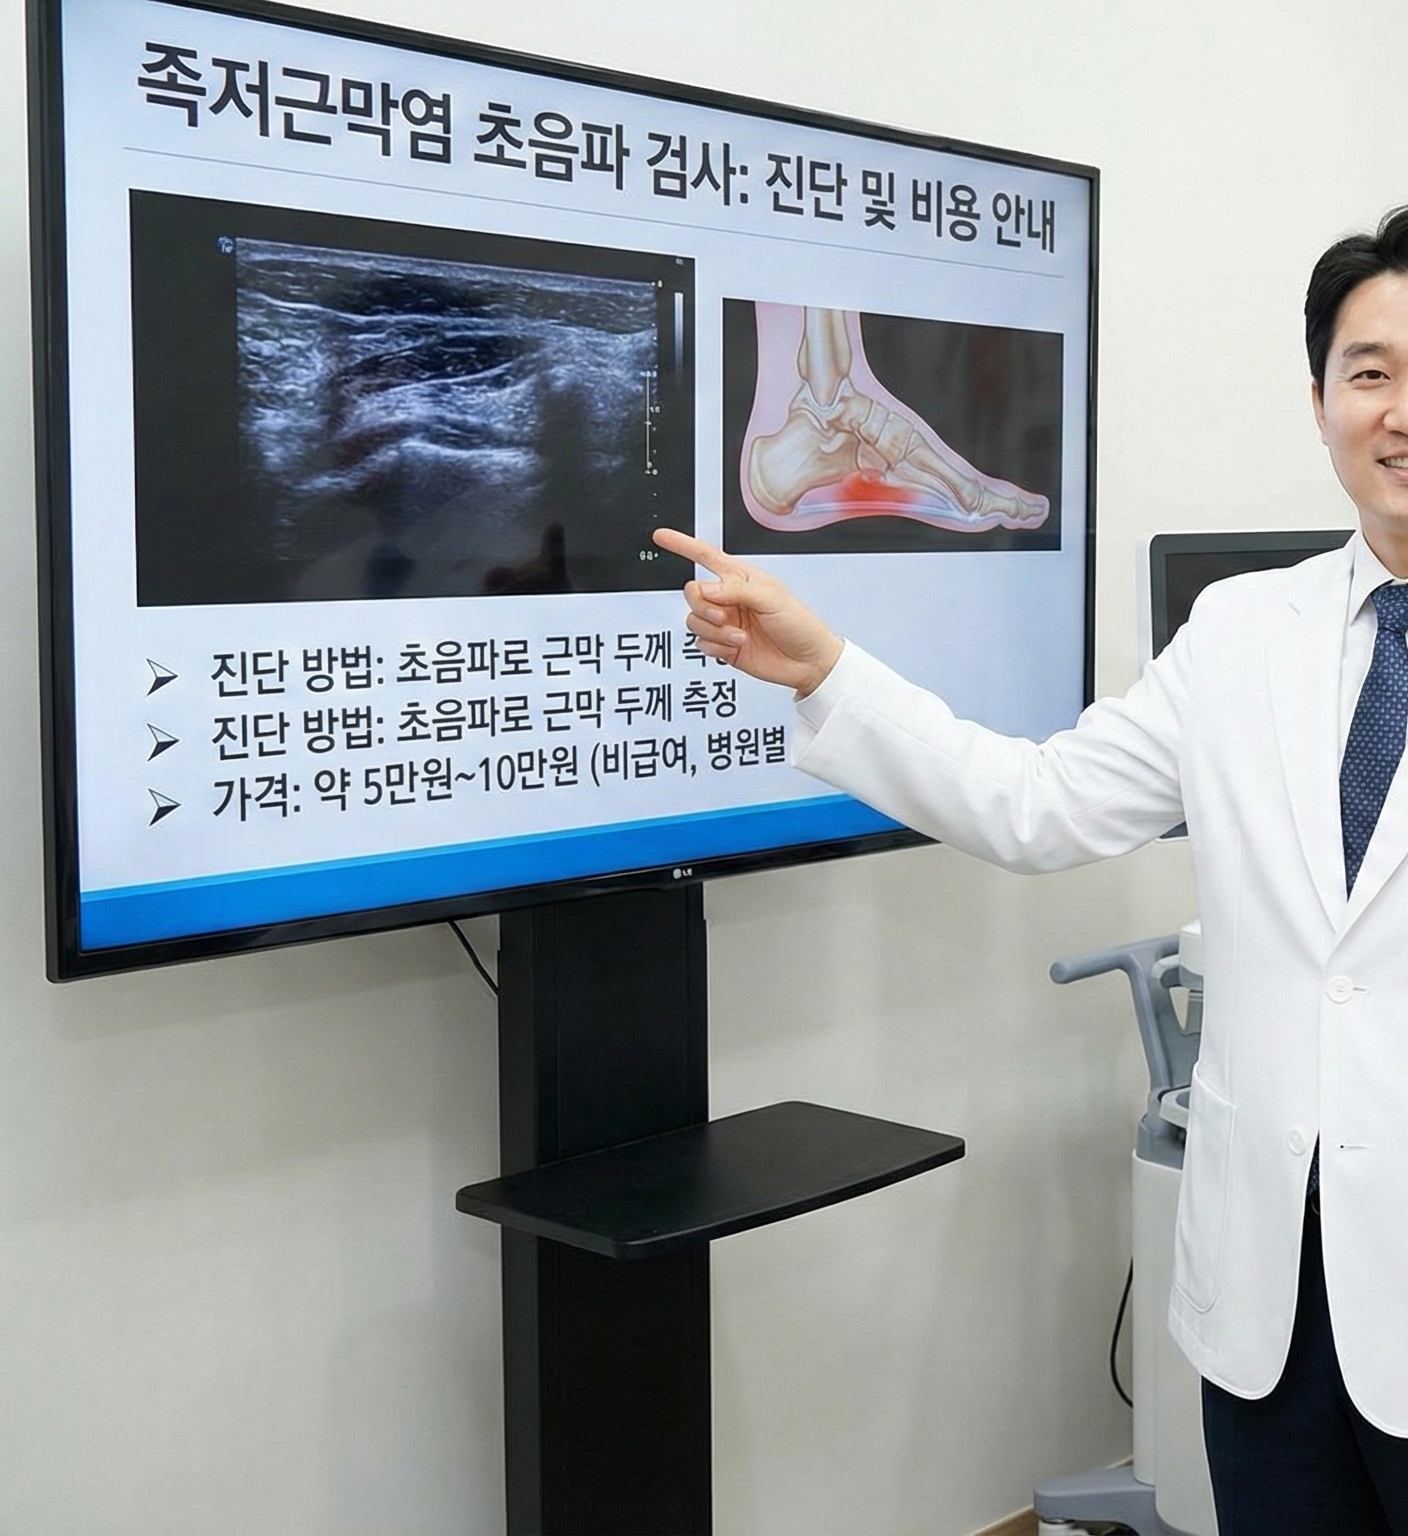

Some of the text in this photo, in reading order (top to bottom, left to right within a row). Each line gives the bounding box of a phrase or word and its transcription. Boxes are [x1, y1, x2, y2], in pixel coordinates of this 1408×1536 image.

[137, 41, 1055, 254] 족저근막염 초음파 검사: 진단 및 비용 안내
[211, 649, 290, 698] 진단
[302, 645, 384, 693] 방법:
[396, 638, 533, 684] 초음파로
[542, 633, 605, 677] 근막
[613, 630, 672, 672] 두께
[211, 678, 737, 761] 진단 방법: 초음파로 근막 두께 측정
[212, 725, 786, 822] 가격: 약 5만원~10만원 (비급여, 병원별
